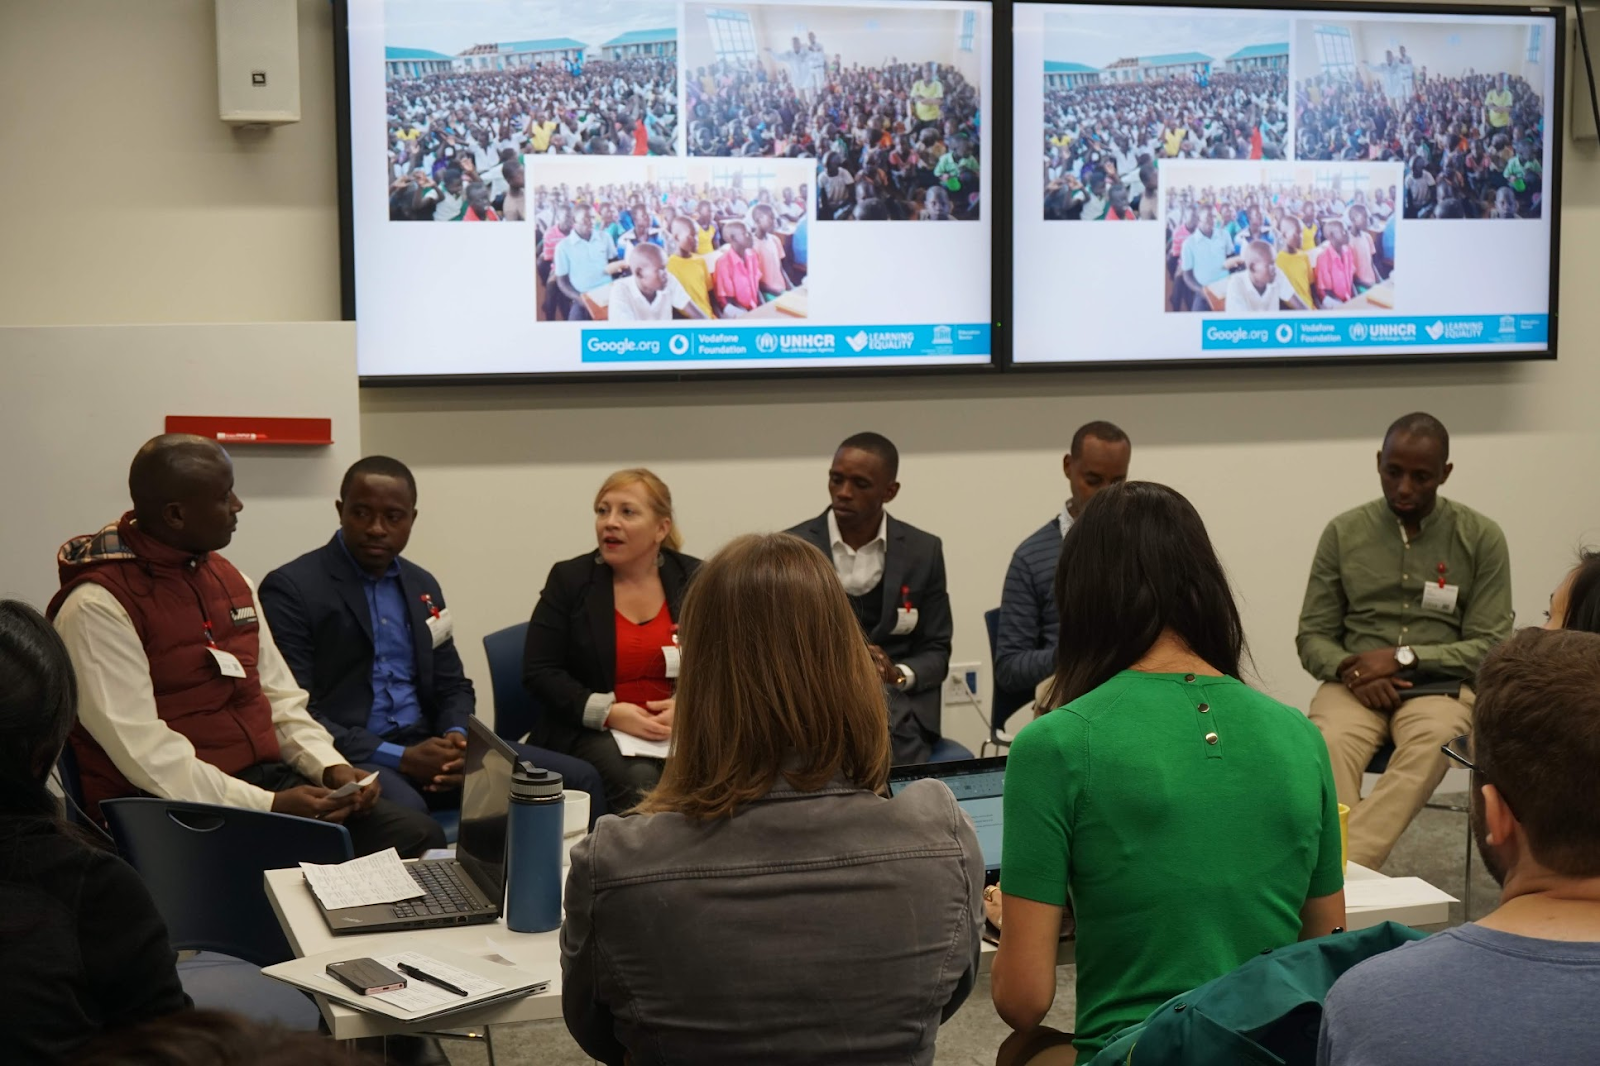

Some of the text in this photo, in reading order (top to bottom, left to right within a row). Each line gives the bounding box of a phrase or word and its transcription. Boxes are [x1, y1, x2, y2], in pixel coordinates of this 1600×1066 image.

[1301, 323, 1334, 332] Vodafone
[1370, 323, 1416, 337] UNHCR
[1444, 321, 1483, 331] LEARNING
[698, 333, 738, 343] Vodafone
[869, 332, 914, 342] LEARNING
[1207, 326, 1268, 343] Google.org
[1301, 333, 1341, 343] Foundation
[1444, 329, 1481, 339] EQUALITY
[587, 337, 660, 354] Google.org
[780, 334, 835, 348] UNHCR
[869, 340, 913, 350] EQUALITY
[698, 344, 747, 354] Foundation
